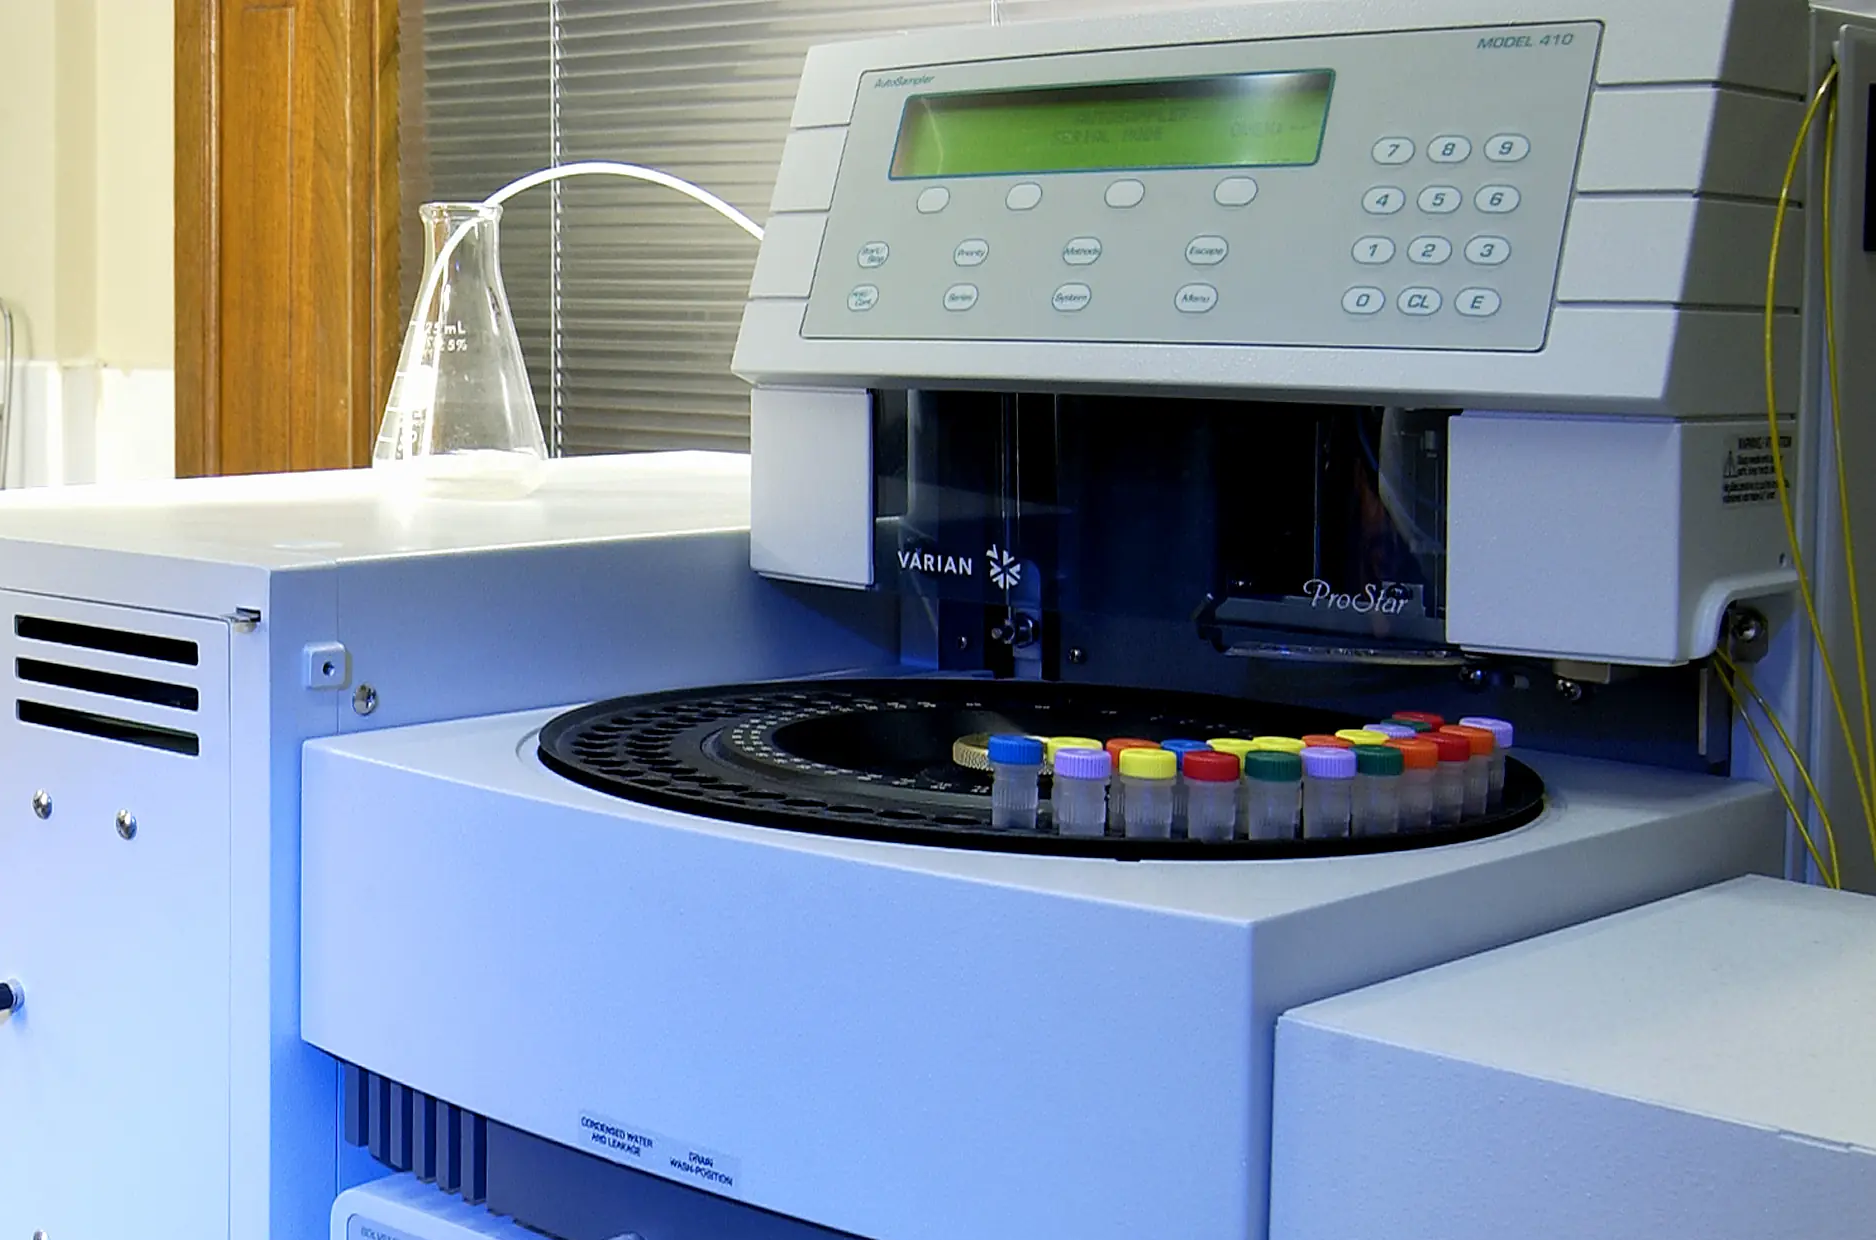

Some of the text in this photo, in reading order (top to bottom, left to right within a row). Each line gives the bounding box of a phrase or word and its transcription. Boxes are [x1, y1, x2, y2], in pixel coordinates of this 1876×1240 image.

[1477, 33, 1574, 49] MODEL 410
[874, 74, 936, 90] AutoSampler
[1387, 141, 1513, 157] 7 8 9
[1376, 192, 1504, 208] 4 5 6
[1189, 246, 1225, 258] Escape
[1369, 244, 1494, 258] 1 2 3
[1181, 293, 1210, 303] Menu
[1407, 294, 1430, 309] CL
[1470, 295, 1484, 310] E
[897, 550, 972, 576] VARIAN
[1303, 578, 1409, 616] ProStar
[626, 1131, 654, 1149] WATER
